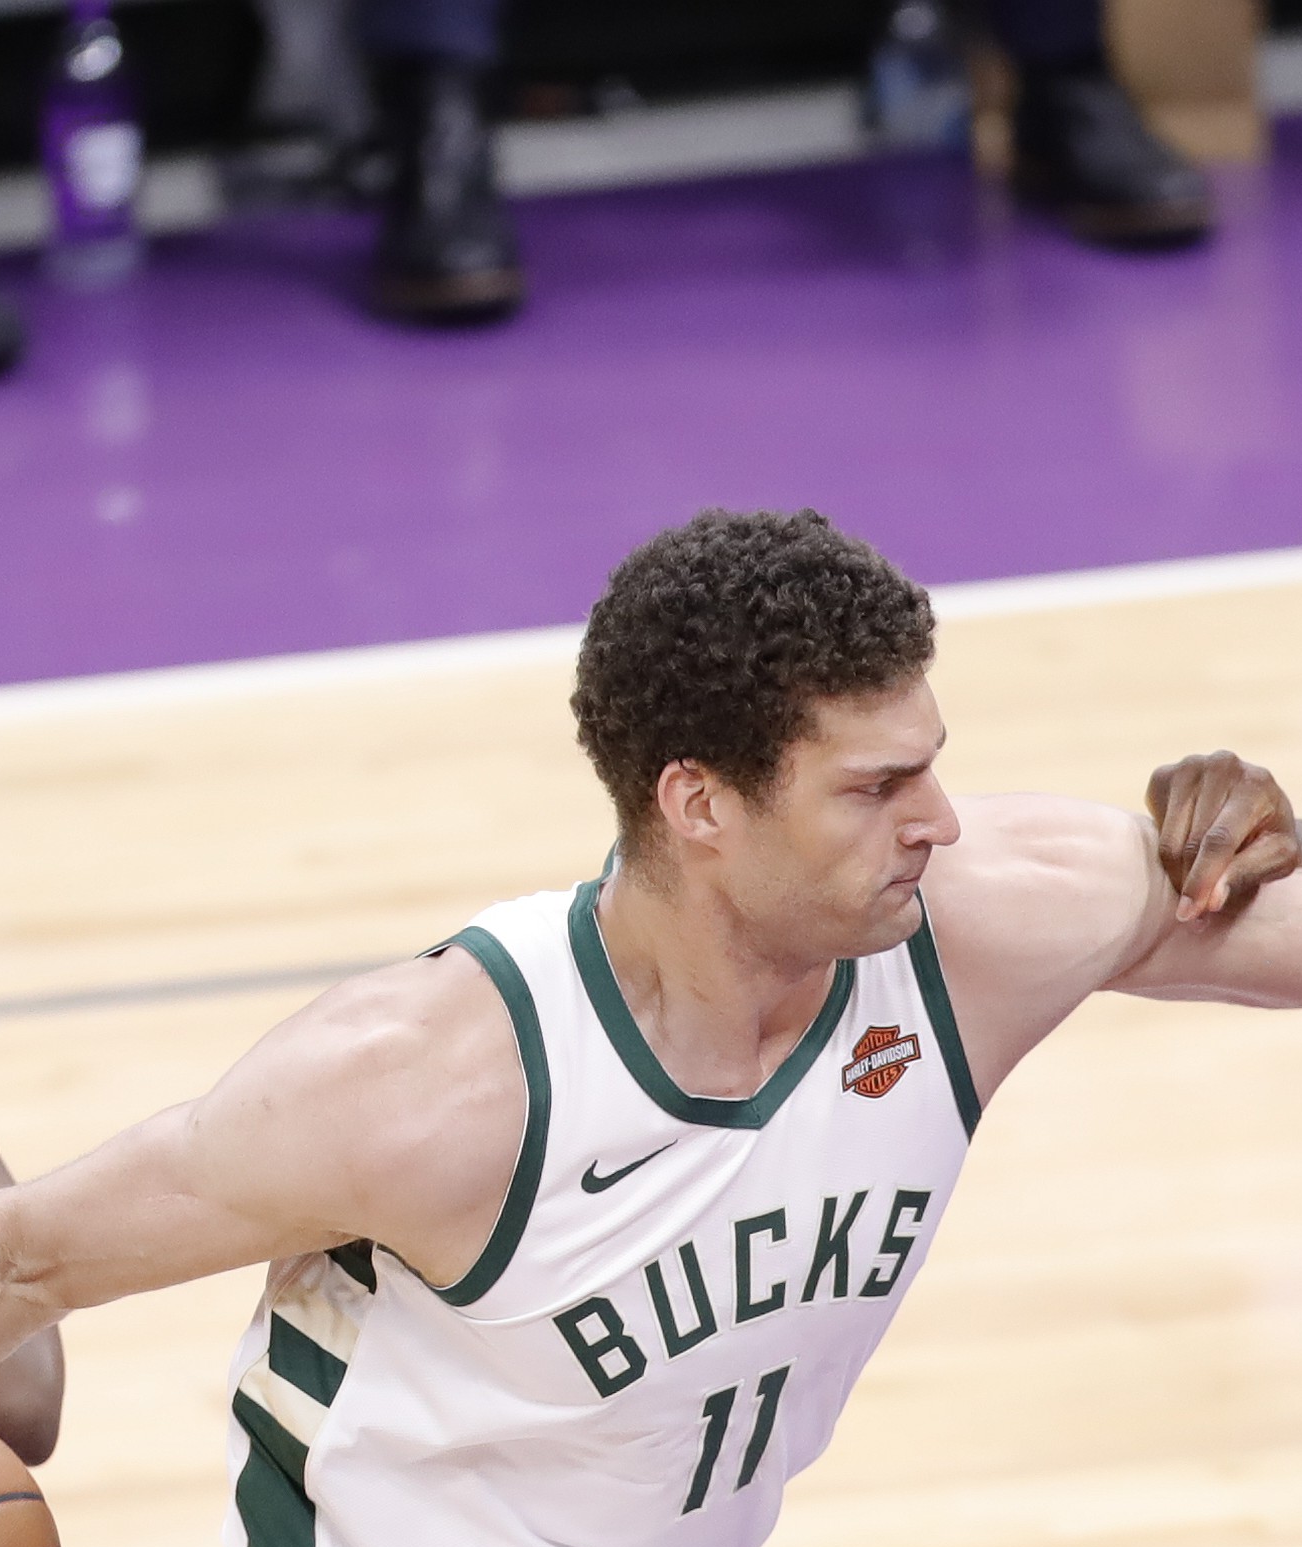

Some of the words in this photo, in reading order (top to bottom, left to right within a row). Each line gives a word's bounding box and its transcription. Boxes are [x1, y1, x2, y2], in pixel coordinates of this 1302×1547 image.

[845, 1040, 915, 1085] HARLEY-DAVIDSON
[857, 1032, 893, 1056] MOTOR
[860, 1066, 898, 1093] CYCLES
[550, 1185, 938, 1400] BUCKS
[678, 1360, 796, 1518] 11
